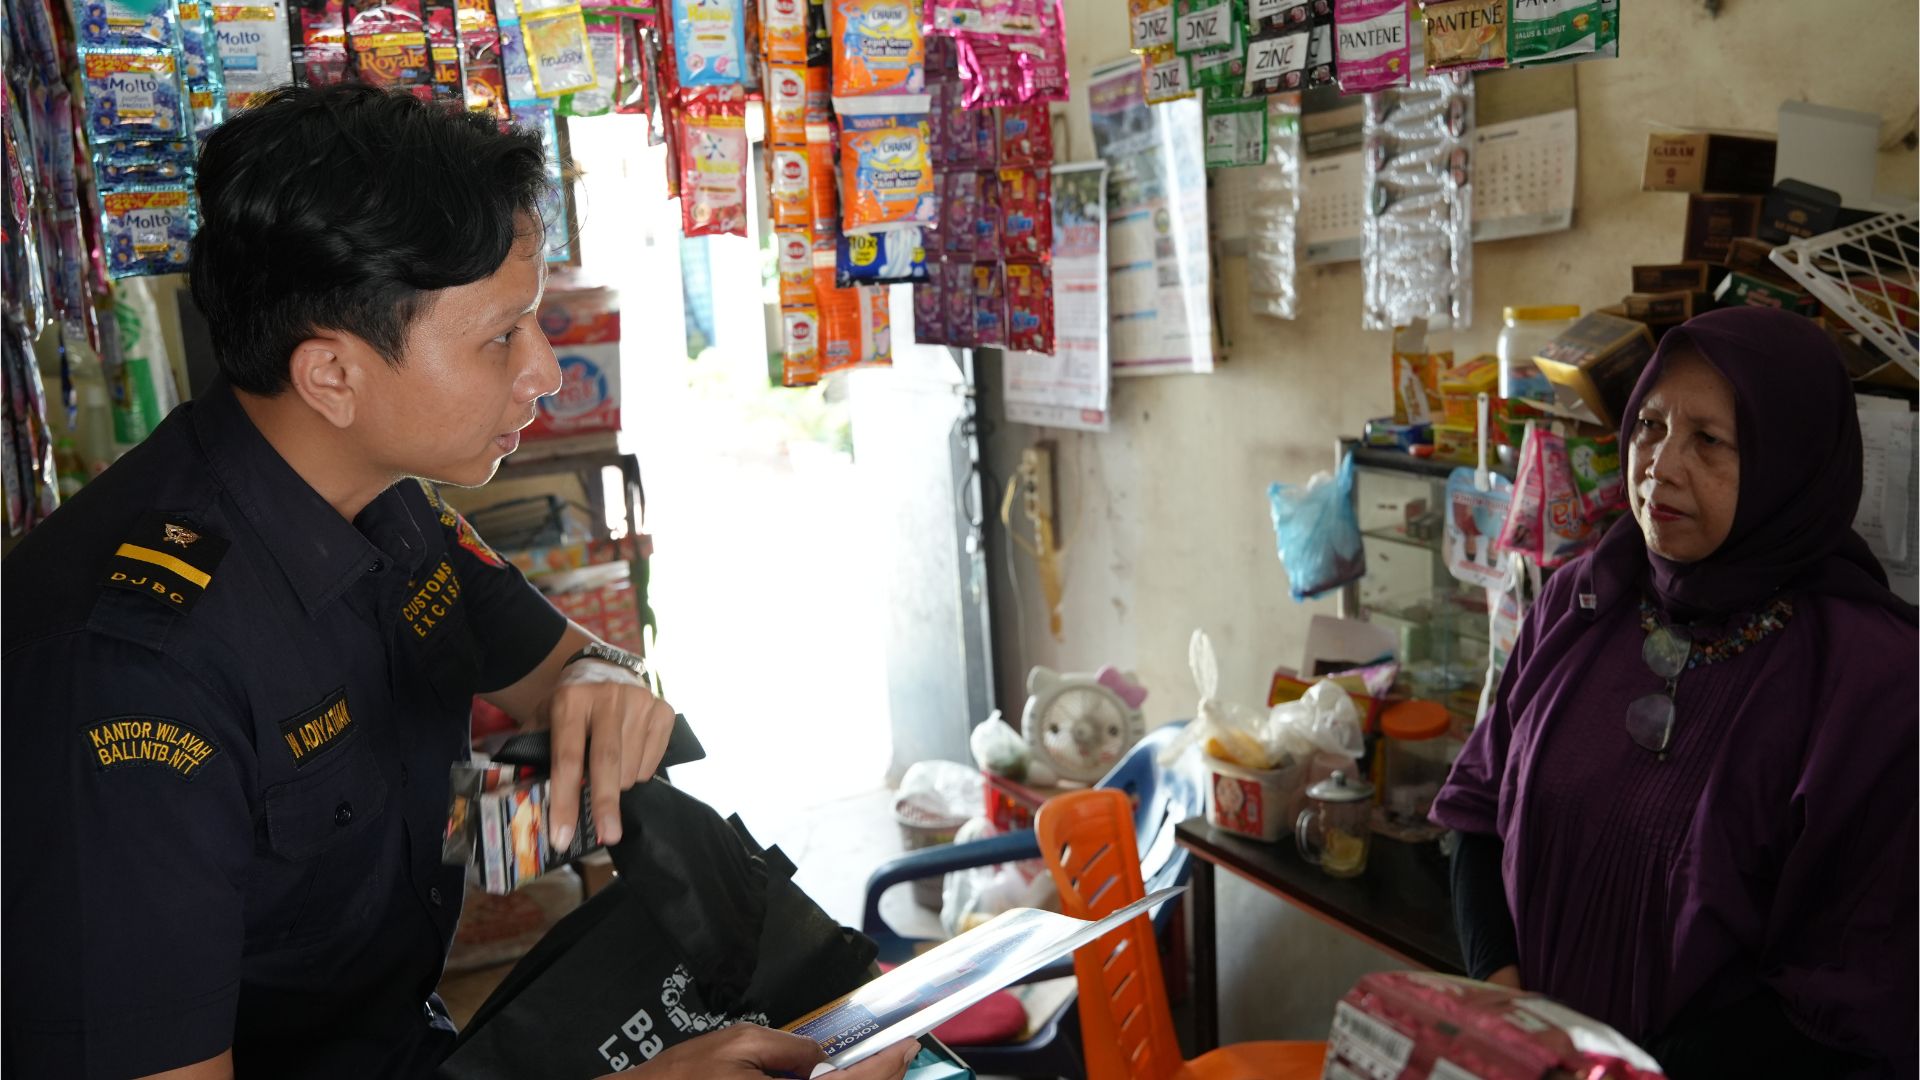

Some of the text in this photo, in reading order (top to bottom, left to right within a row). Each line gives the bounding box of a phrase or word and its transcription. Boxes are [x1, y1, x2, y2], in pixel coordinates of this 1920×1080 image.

[1426, 6, 1504, 36] PANTENE
[216, 30, 261, 45] Molto
[1340, 26, 1402, 49] PANTENE
[359, 48, 425, 80] Royale
[1255, 44, 1295, 70] ZINC
[109, 78, 158, 93] Molto
[126, 214, 171, 229] Molto
[110, 571, 185, 604] DJBC
[402, 561, 453, 622] CUSTOMS
[89, 721, 213, 761] KANTOR WILAYAH
[836, 1023, 880, 1049] ROKOK
[837, 1018, 874, 1040] CUKAI
[597, 1033, 636, 1072] La
